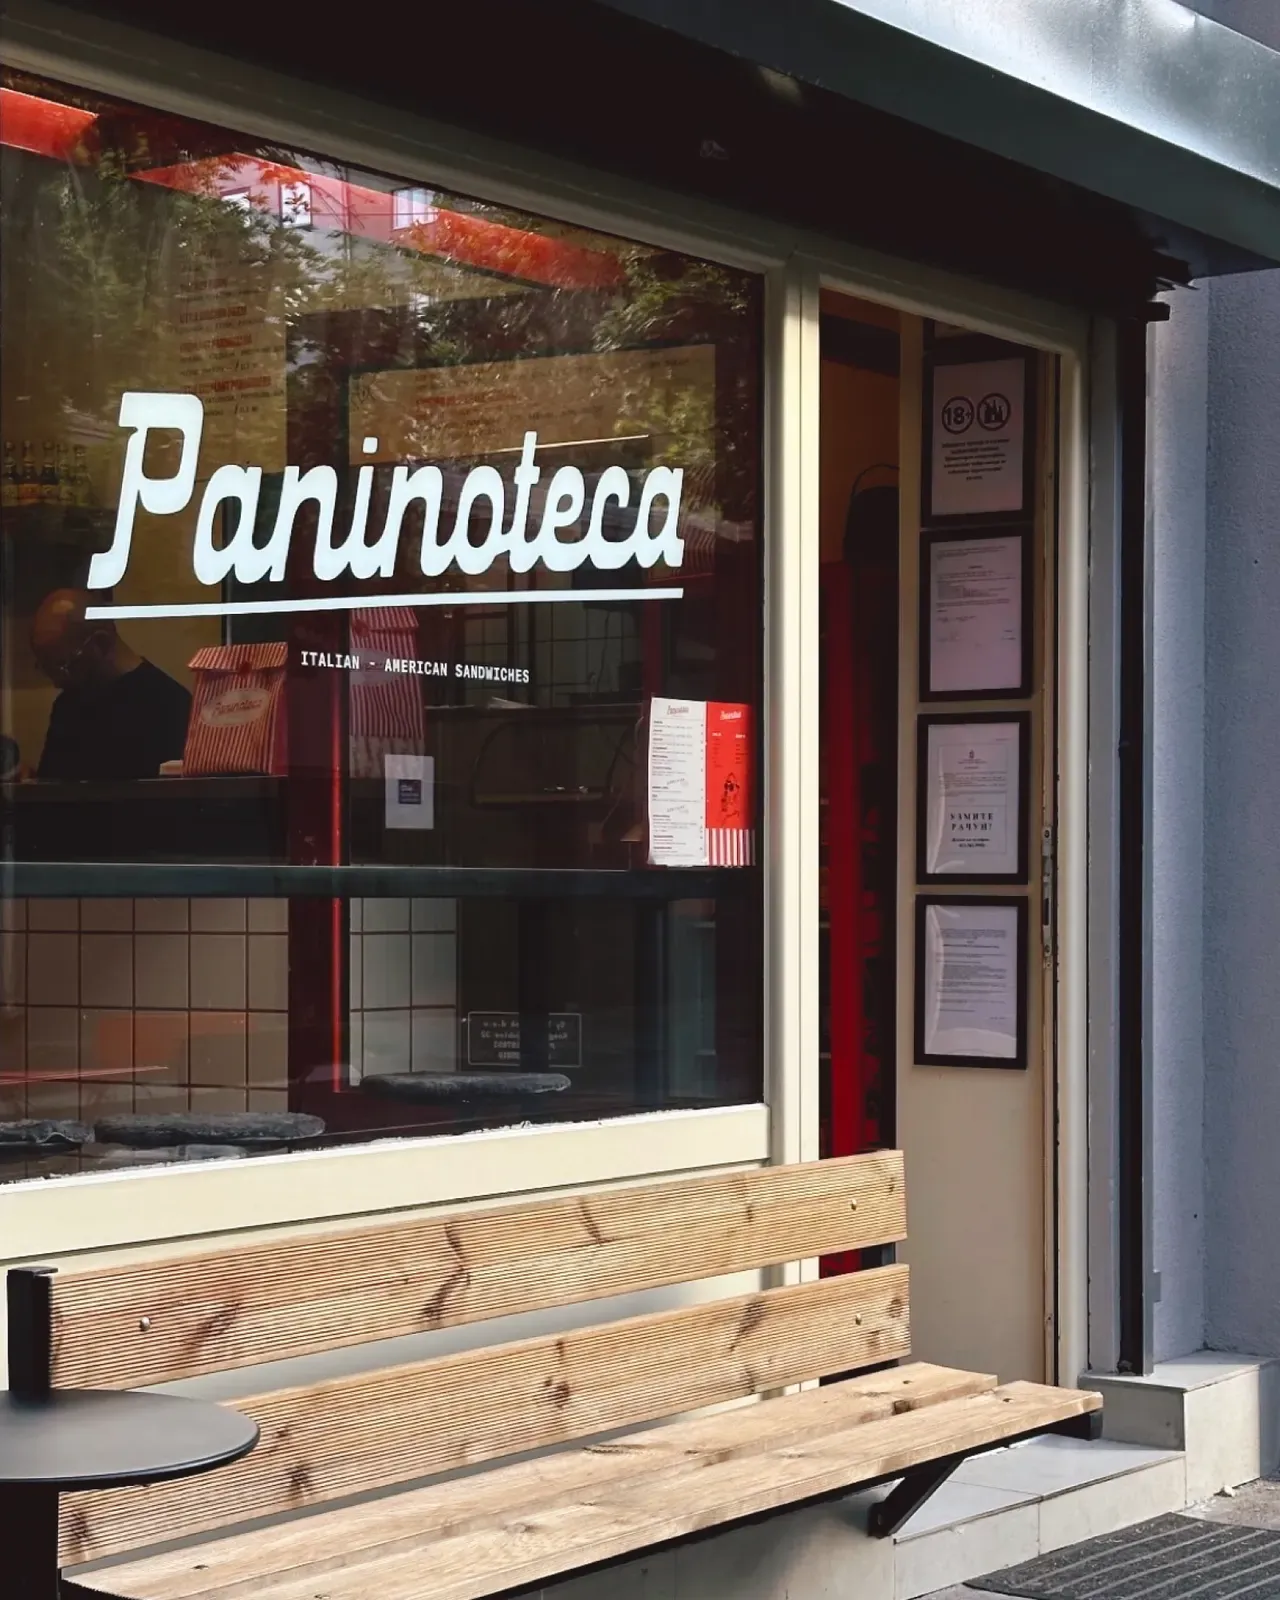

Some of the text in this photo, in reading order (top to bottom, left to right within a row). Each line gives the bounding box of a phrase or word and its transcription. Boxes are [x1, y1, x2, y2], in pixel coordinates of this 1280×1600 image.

[944, 407, 972, 427] 18+
[88, 392, 685, 590] Paninoteca
[301, 651, 361, 671] ITALIAN
[384, 658, 449, 679] AMERICAN
[455, 663, 530, 684] SANDWICHES
